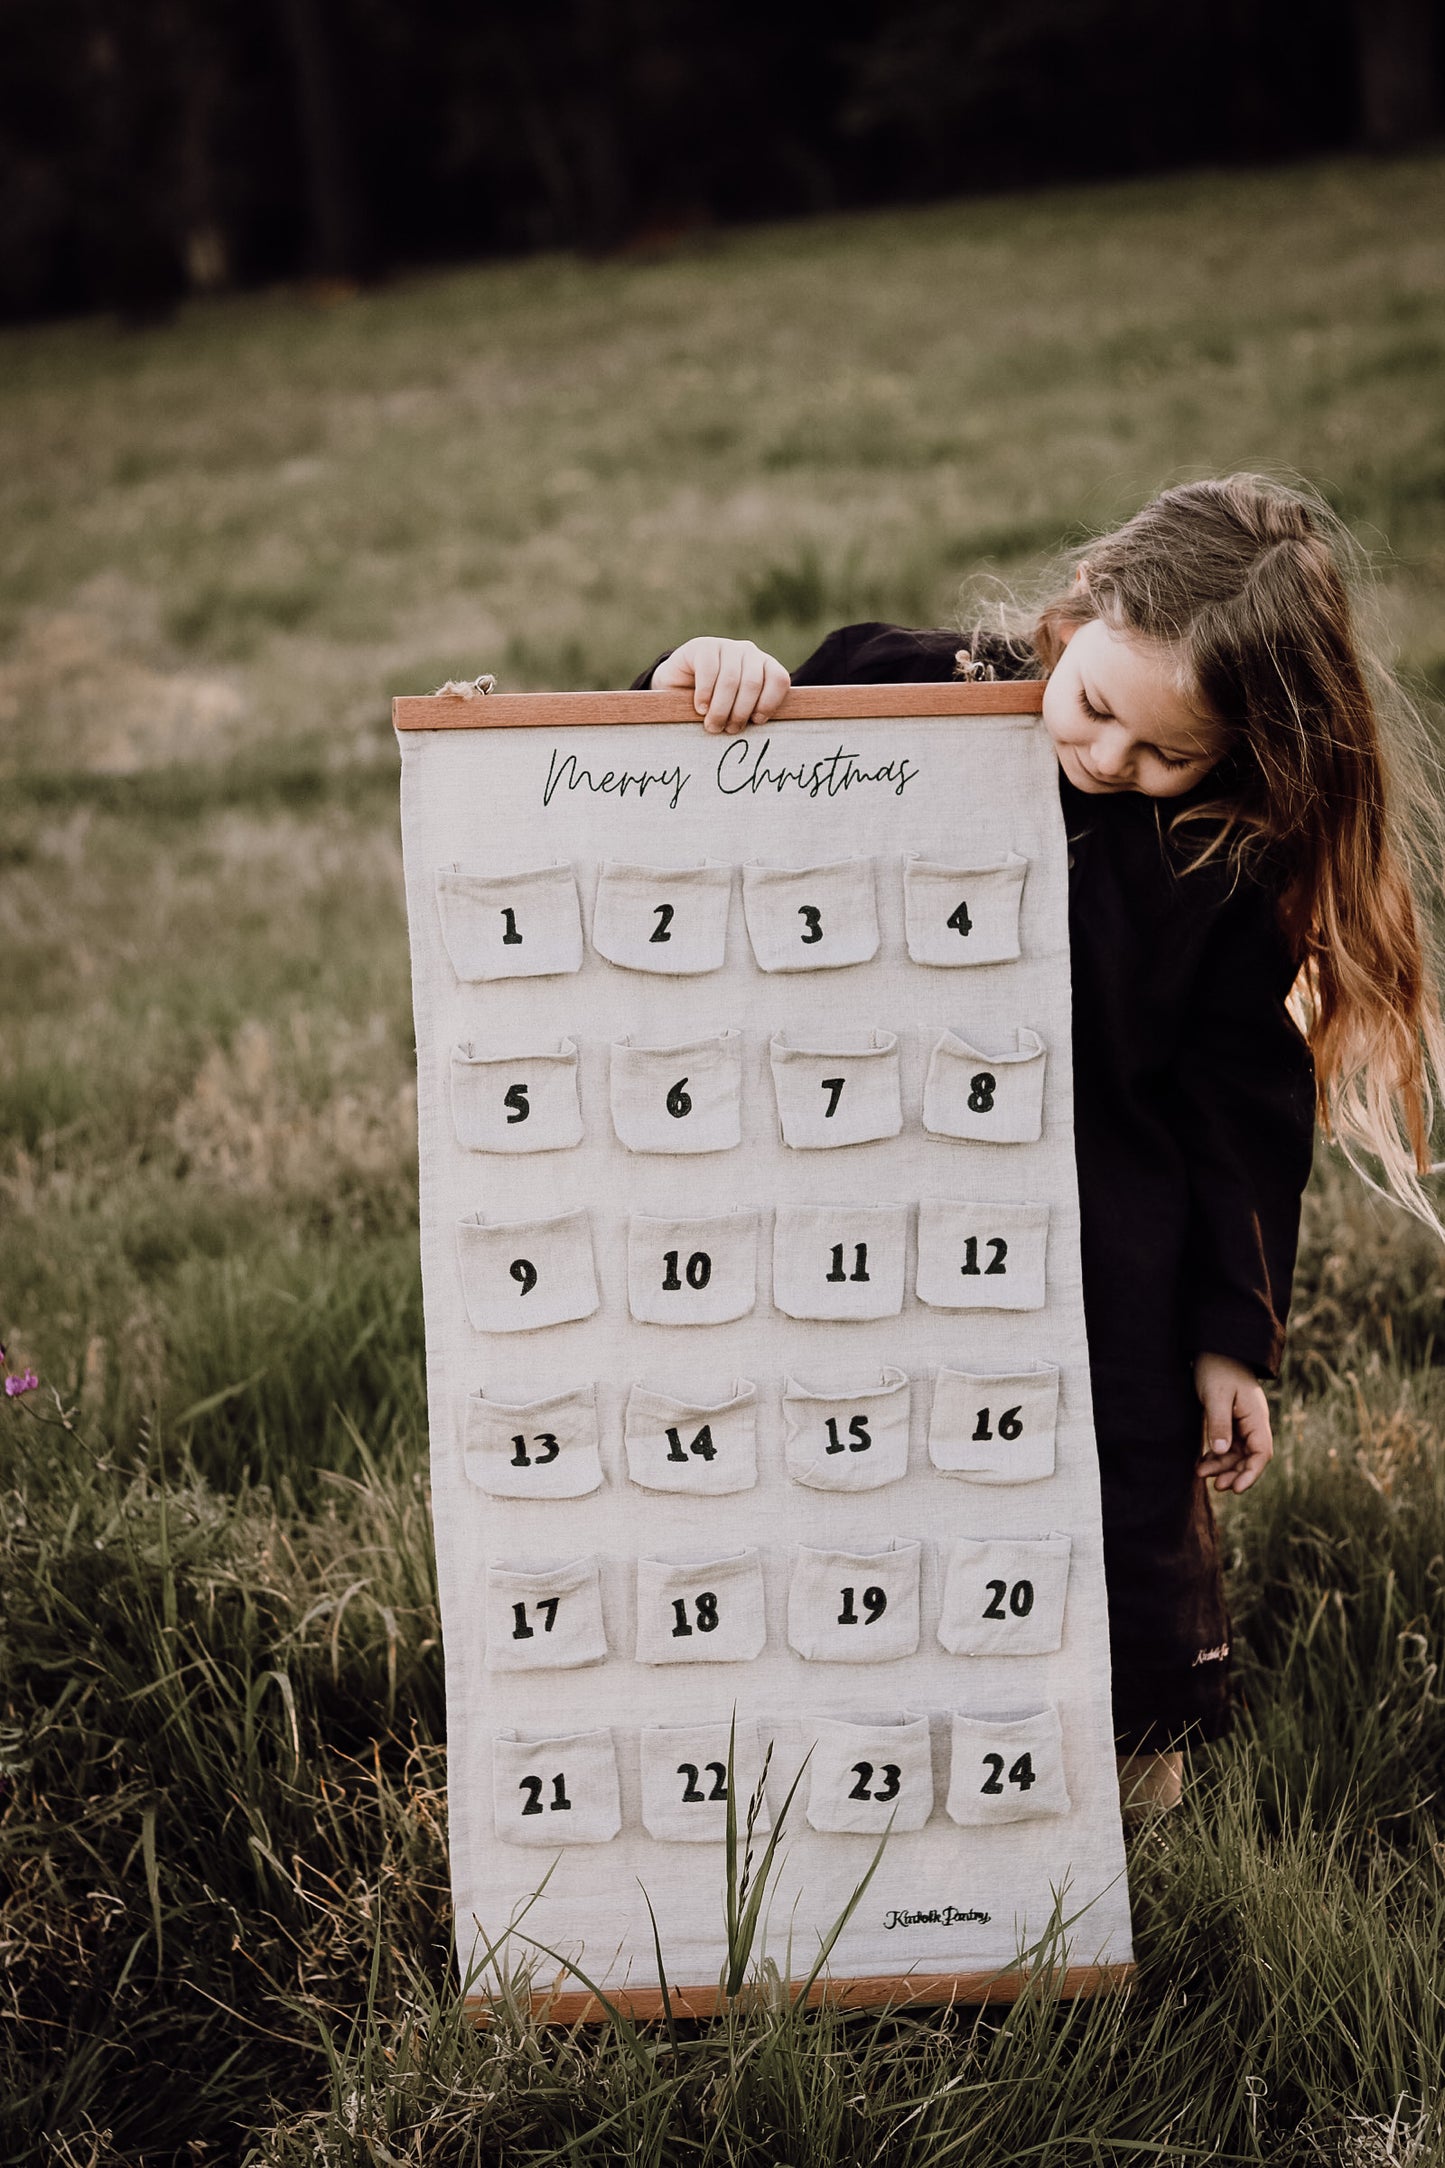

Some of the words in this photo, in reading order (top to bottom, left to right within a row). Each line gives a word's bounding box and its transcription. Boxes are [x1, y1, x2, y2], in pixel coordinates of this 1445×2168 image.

[544, 749, 690, 809] Merry
[718, 739, 919, 798] Christmas
[501, 908, 522, 944] 1
[649, 904, 674, 942] 2
[798, 906, 823, 943] 3
[947, 902, 972, 936] 4
[504, 1085, 529, 1123] 5
[667, 1078, 691, 1118] 6
[822, 1078, 845, 1117] 7
[968, 1073, 996, 1113] 8
[663, 1251, 711, 1290] 10
[826, 1243, 870, 1282] 11
[961, 1237, 1007, 1275] 12
[510, 1259, 537, 1296] 9
[825, 1416, 871, 1454] 15
[972, 1406, 1023, 1441] 16
[511, 1434, 559, 1466] 13
[665, 1425, 717, 1462] 14
[512, 1598, 560, 1639] 17
[672, 1592, 718, 1637] 18
[838, 1587, 887, 1625] 19
[982, 1580, 1033, 1619] 20
[676, 1761, 729, 1803] 22
[849, 1762, 901, 1802] 23
[981, 1753, 1035, 1794] 24
[519, 1773, 571, 1815] 21
